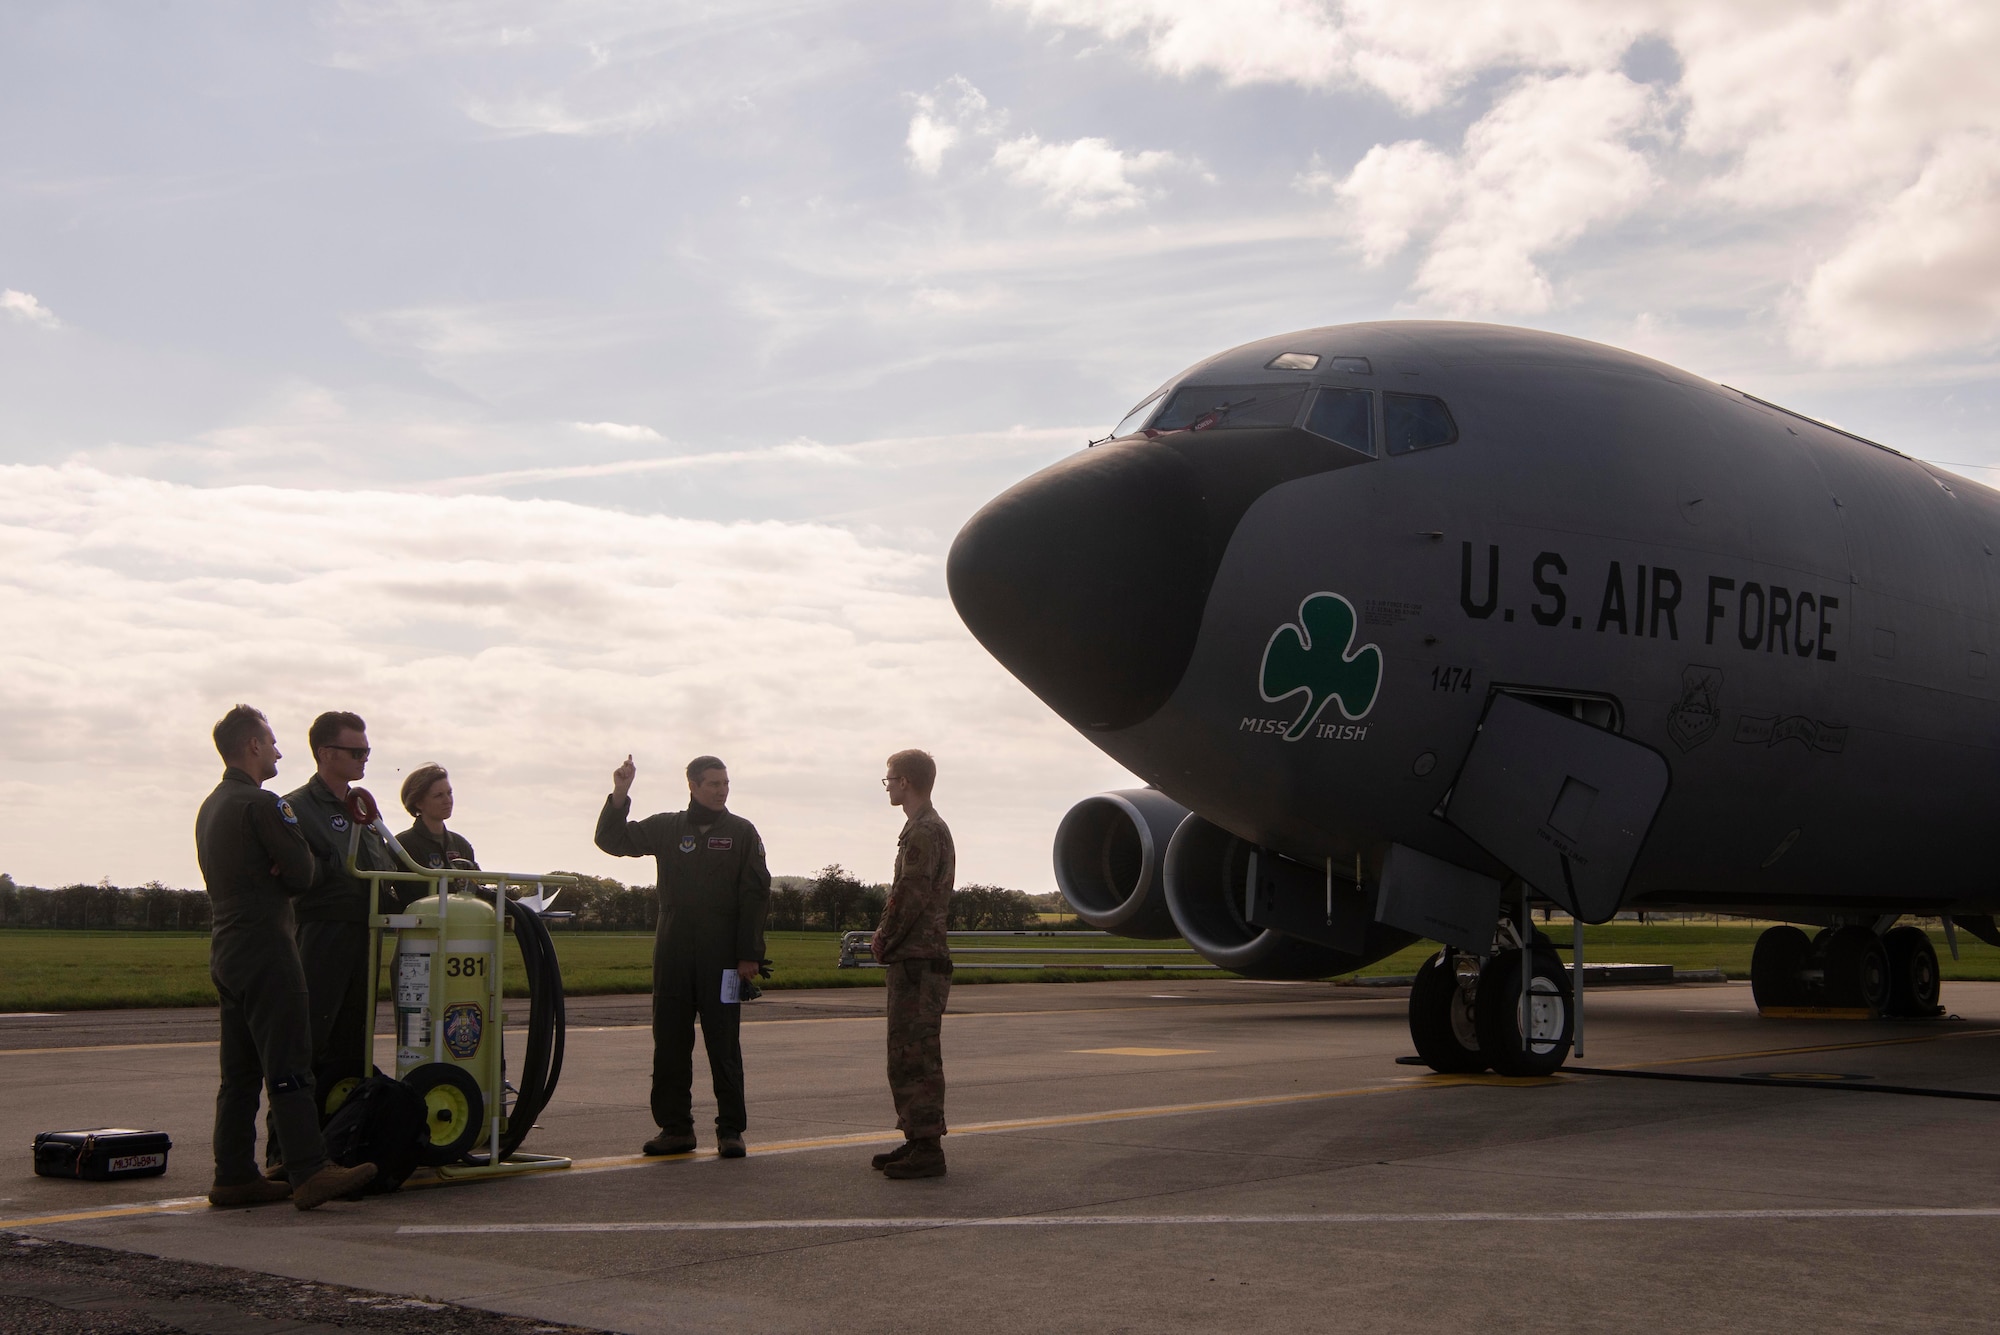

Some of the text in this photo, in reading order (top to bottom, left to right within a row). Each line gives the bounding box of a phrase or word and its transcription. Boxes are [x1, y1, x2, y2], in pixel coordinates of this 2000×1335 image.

[1597, 561, 1682, 640] AIR
[1705, 575, 1838, 661] FORCE
[1431, 665, 1472, 693] 1474
[1239, 717, 1289, 734] MISS
[1536, 827, 1552, 842] TOW
[1553, 839, 1568, 852] BAR
[447, 957, 484, 977] 381
